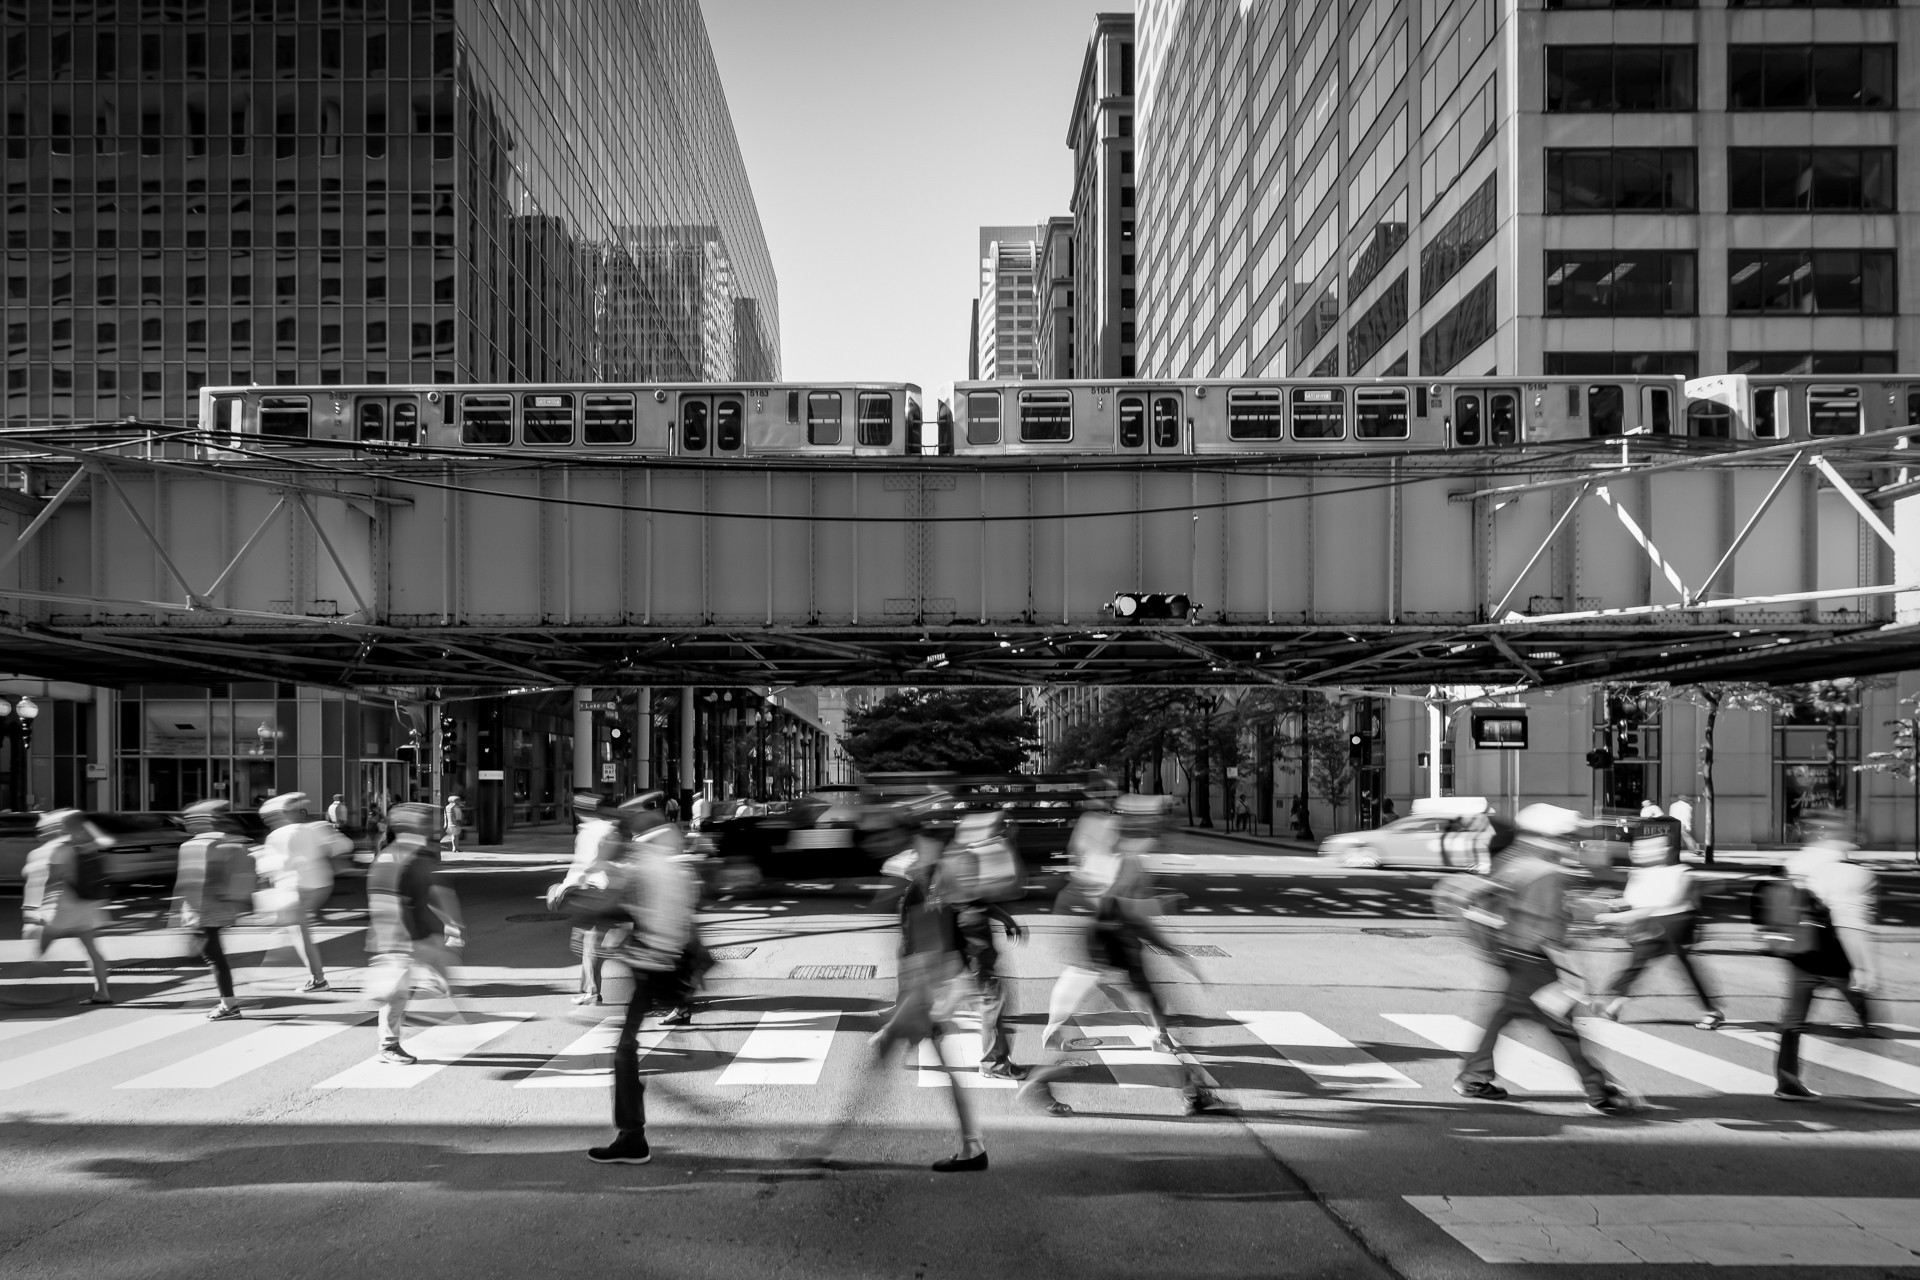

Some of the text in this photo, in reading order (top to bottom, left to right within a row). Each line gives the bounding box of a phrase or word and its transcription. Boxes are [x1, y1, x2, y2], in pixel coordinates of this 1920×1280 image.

[1091, 387, 1111, 395] 5184
[1528, 383, 1548, 391] 5184
[749, 389, 769, 397] 5183
[1785, 768, 1840, 777] STRBUCS
[1643, 826, 1670, 835] BEST
